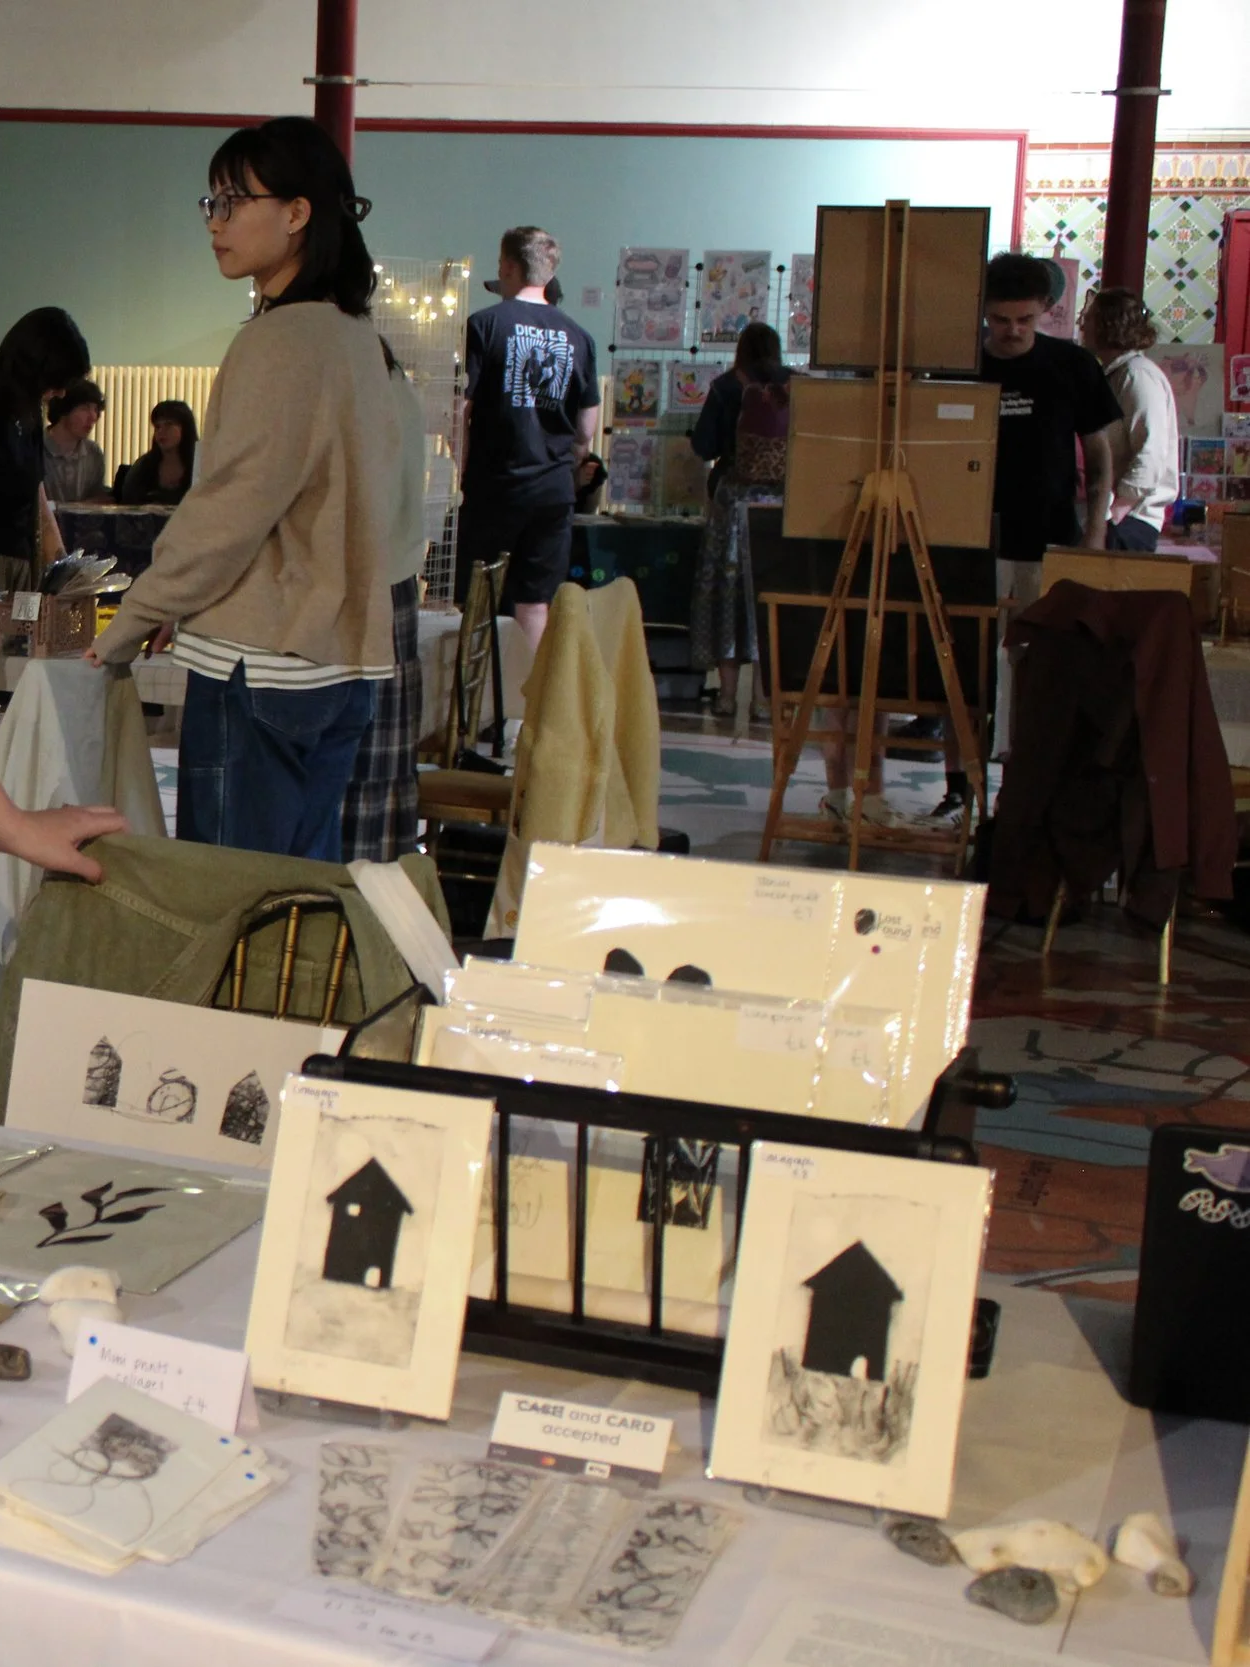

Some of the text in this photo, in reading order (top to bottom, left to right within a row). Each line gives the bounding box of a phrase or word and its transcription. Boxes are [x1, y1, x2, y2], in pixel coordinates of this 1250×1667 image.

[515, 323, 568, 343] DICKIES
[504, 335, 516, 393] WORLDWIDE
[568, 1408, 603, 1425] and
[605, 1414, 656, 1434] CARD
[541, 1423, 622, 1447] accepted
